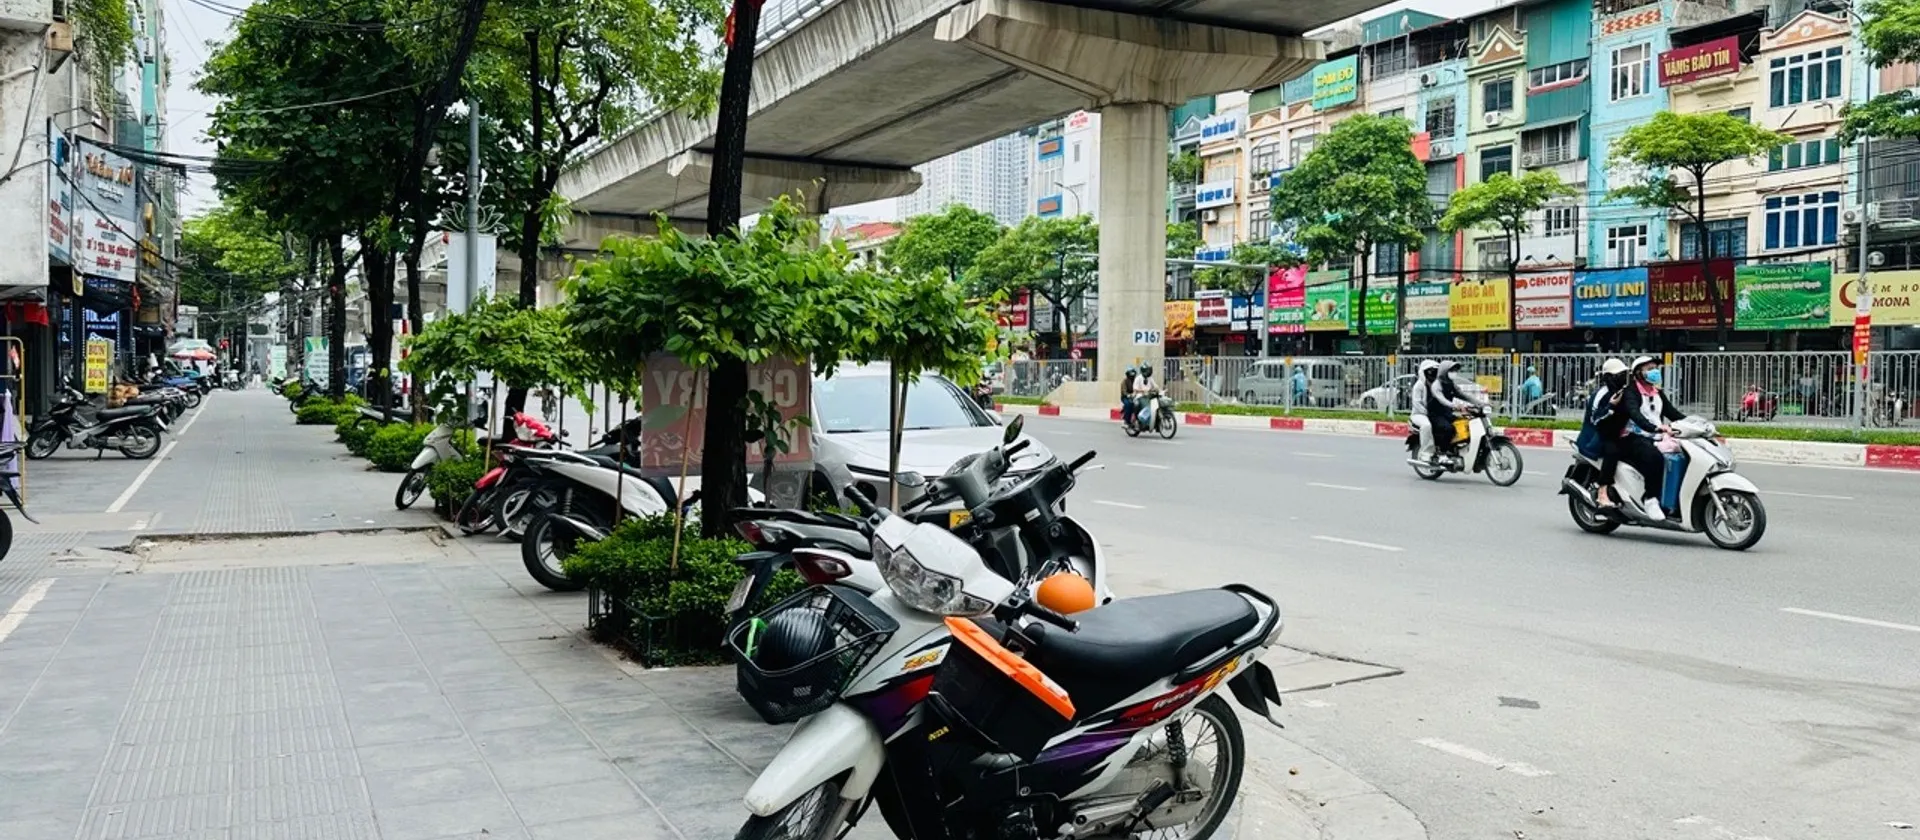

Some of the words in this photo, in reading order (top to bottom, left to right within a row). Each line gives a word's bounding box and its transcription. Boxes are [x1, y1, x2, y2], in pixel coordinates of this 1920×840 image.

[1664, 57, 1690, 77] VÀNG
[1691, 49, 1711, 72] BẢO
[1712, 46, 1730, 67] TÍN
[1529, 276, 1568, 287] CENTOSY
[1615, 280, 1645, 297] LINH
[1872, 296, 1910, 308] MONA
